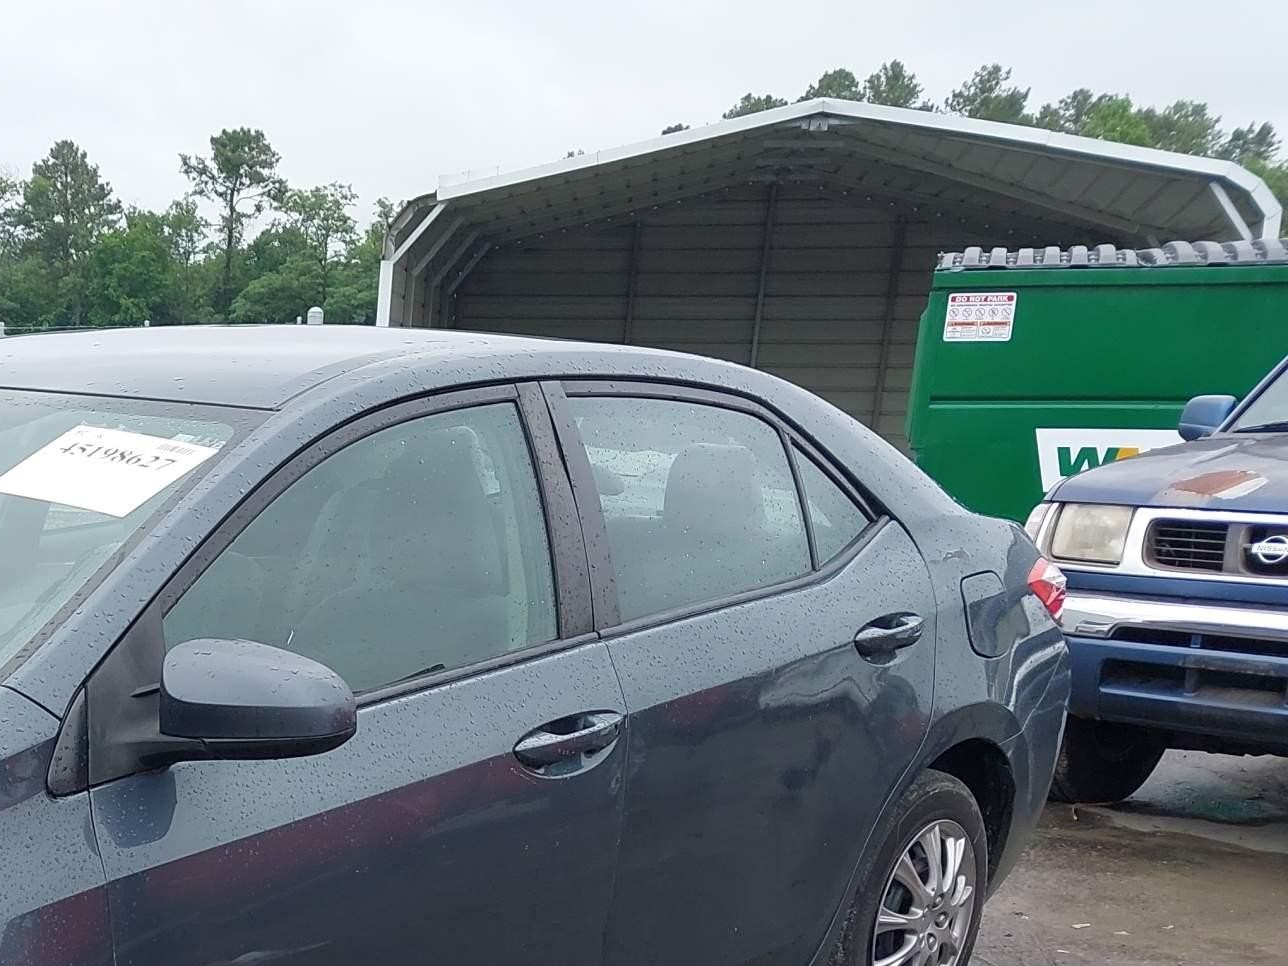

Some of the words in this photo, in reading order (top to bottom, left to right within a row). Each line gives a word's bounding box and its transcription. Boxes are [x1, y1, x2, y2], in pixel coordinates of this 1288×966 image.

[955, 295, 967, 303] DO
[969, 295, 987, 303] NOT
[987, 295, 1009, 303] PARK
[59, 441, 176, 471] 45198627
